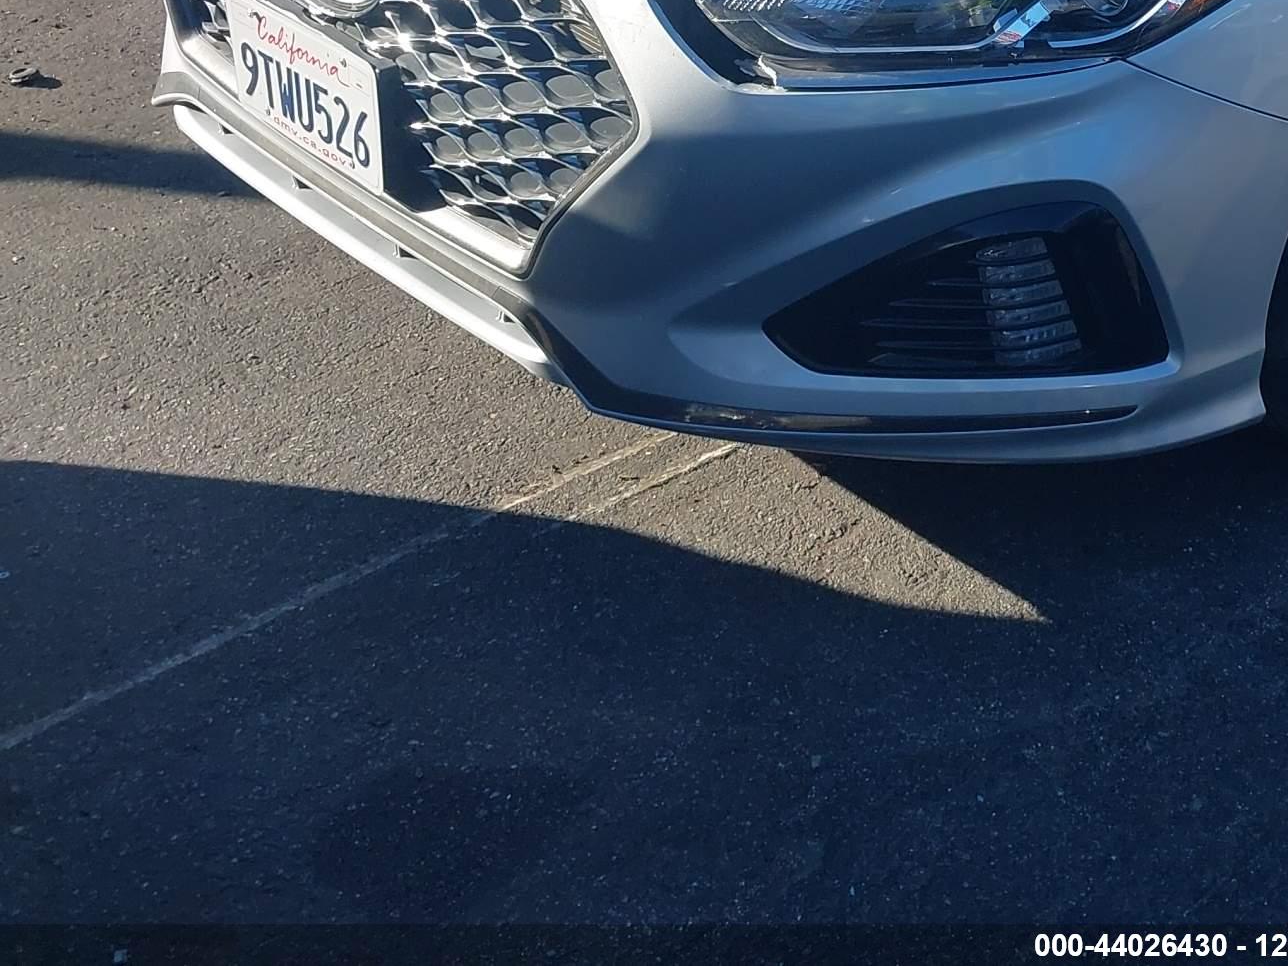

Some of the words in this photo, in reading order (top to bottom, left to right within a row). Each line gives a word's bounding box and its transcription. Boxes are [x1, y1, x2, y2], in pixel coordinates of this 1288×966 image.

[254, 14, 351, 88] California
[240, 41, 370, 169] 9TWU526
[272, 114, 347, 167] dmv.ca.gov
